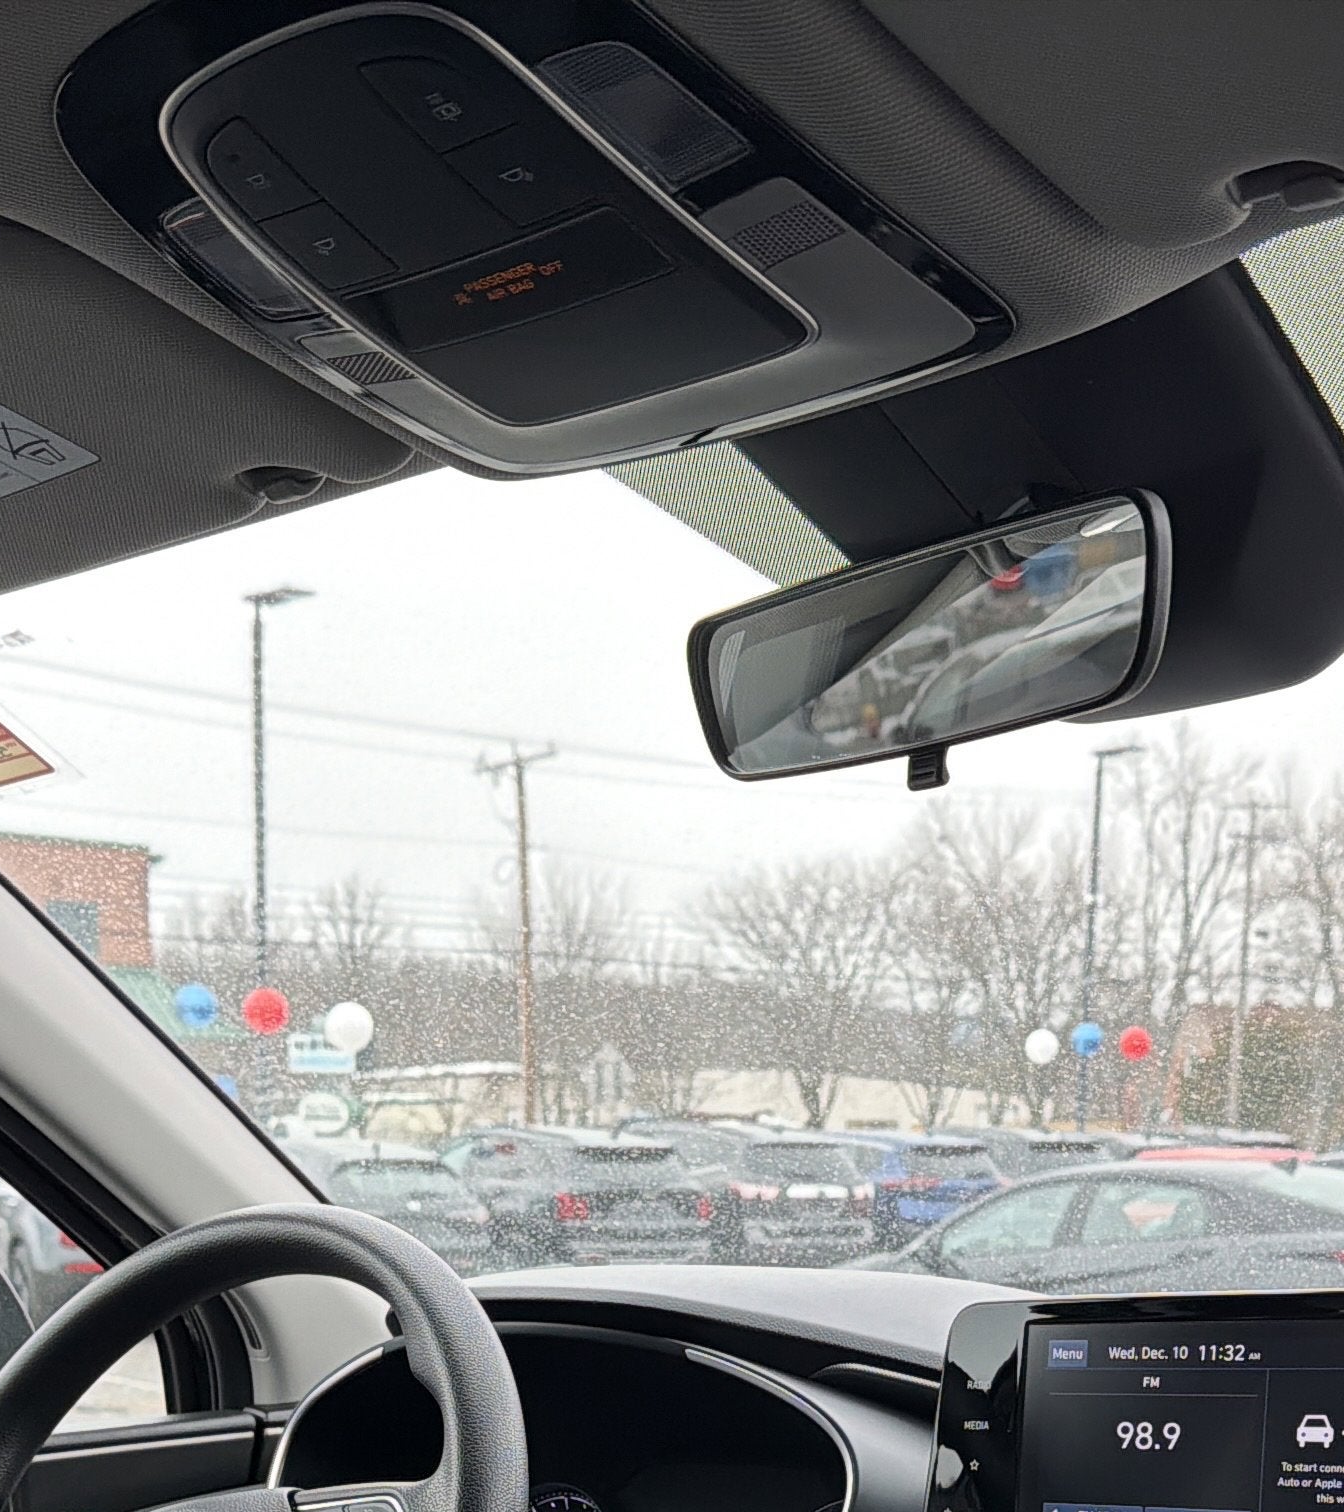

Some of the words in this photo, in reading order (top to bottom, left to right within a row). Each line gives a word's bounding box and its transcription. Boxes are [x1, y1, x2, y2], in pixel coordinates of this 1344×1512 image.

[464, 262, 537, 293] PASSENGER
[538, 260, 564, 275] OFF
[508, 279, 535, 295] BAG
[1052, 1347, 1083, 1360] Menu
[1109, 1346, 1139, 1361] Wed,
[1141, 1346, 1169, 1360] Dec.
[1172, 1346, 1189, 1360] 10
[1199, 1344, 1245, 1362] 11:32
[1248, 1352, 1261, 1360] AM
[1142, 1376, 1161, 1388] FM
[964, 1420, 989, 1430] MEDIA
[1116, 1421, 1181, 1450] 98.9
[1281, 1461, 1293, 1472] To
[1294, 1462, 1318, 1473] start
[1277, 1477, 1300, 1487] Auto
[1301, 1478, 1313, 1488] or
[1314, 1478, 1342, 1490] Apple
[1316, 1493, 1335, 1504] this
